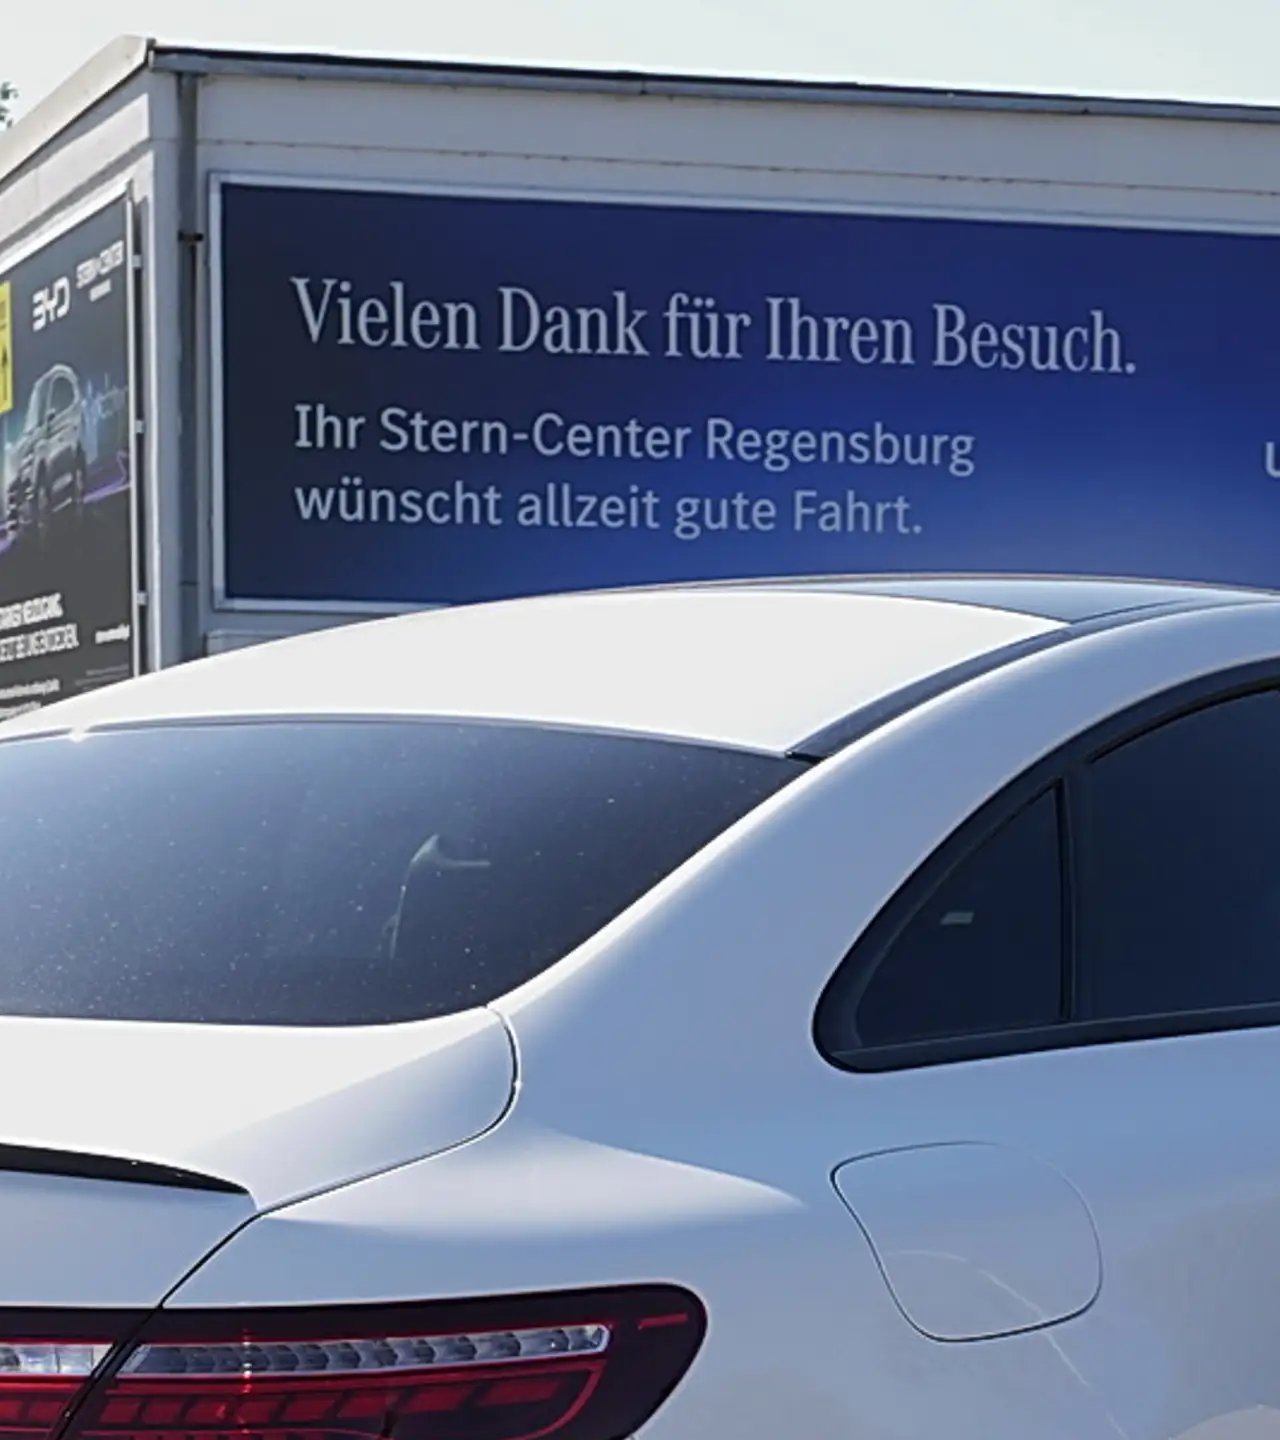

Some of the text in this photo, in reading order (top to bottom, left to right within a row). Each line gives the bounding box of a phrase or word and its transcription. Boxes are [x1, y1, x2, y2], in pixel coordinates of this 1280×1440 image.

[32, 276, 70, 332] BYD
[291, 277, 1138, 375] Vielen Dank für Ihren Besuch.
[294, 403, 976, 477] Ihr Stern-Center Regensburg
[294, 476, 923, 540] wünscht allzeit gute Fahrt.
